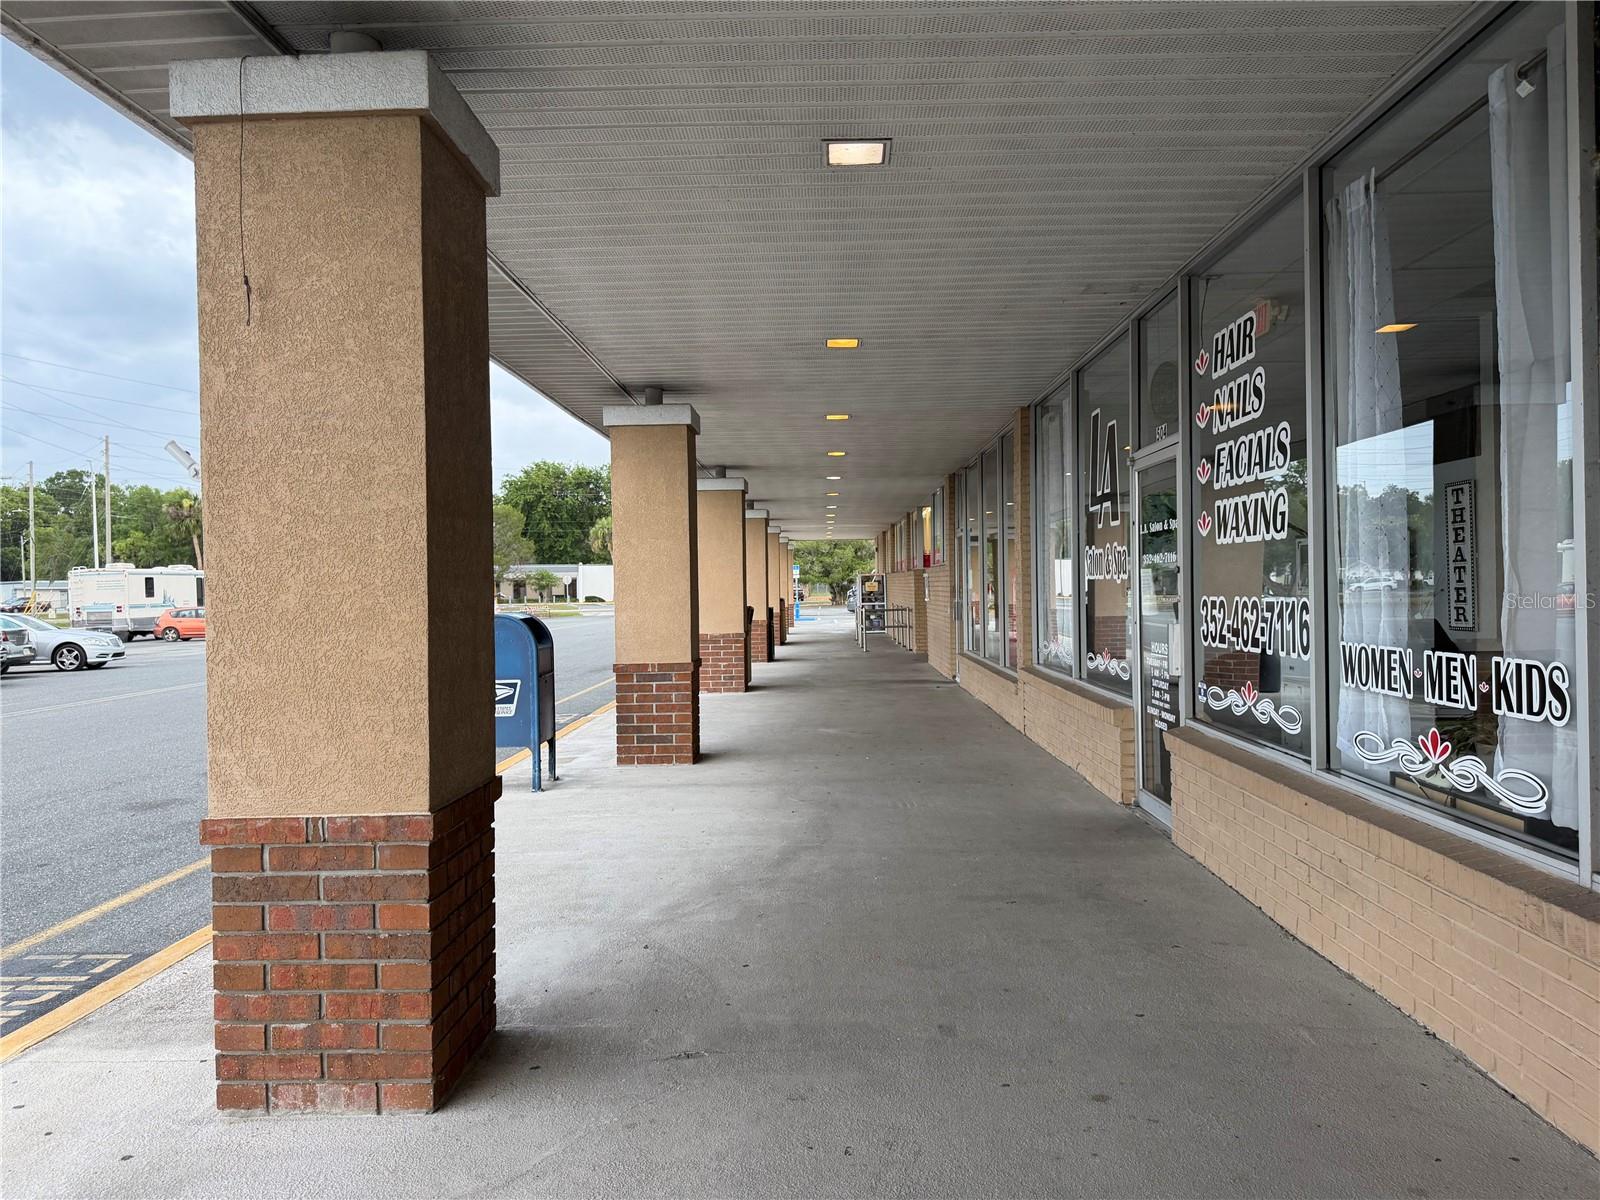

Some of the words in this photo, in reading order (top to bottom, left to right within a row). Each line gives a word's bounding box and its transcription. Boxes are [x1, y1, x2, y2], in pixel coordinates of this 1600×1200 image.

[1212, 311, 1256, 380] HAIR
[1213, 366, 1265, 434] NAILS
[1089, 408, 1120, 528] LA
[1214, 421, 1290, 490] FACIALS
[1215, 486, 1288, 544] WAXING
[1085, 545, 1104, 580] Salon
[1105, 542, 1112, 579] &
[1112, 541, 1128, 584] Spa
[1451, 486, 1469, 623] THEATER
[1200, 595, 1311, 661] 352-462-7116
[1340, 641, 1413, 699] WOMEN
[1424, 650, 1477, 711] MEN
[1492, 656, 1570, 727] KIDS
[0, 953, 133, 1025] FIR
